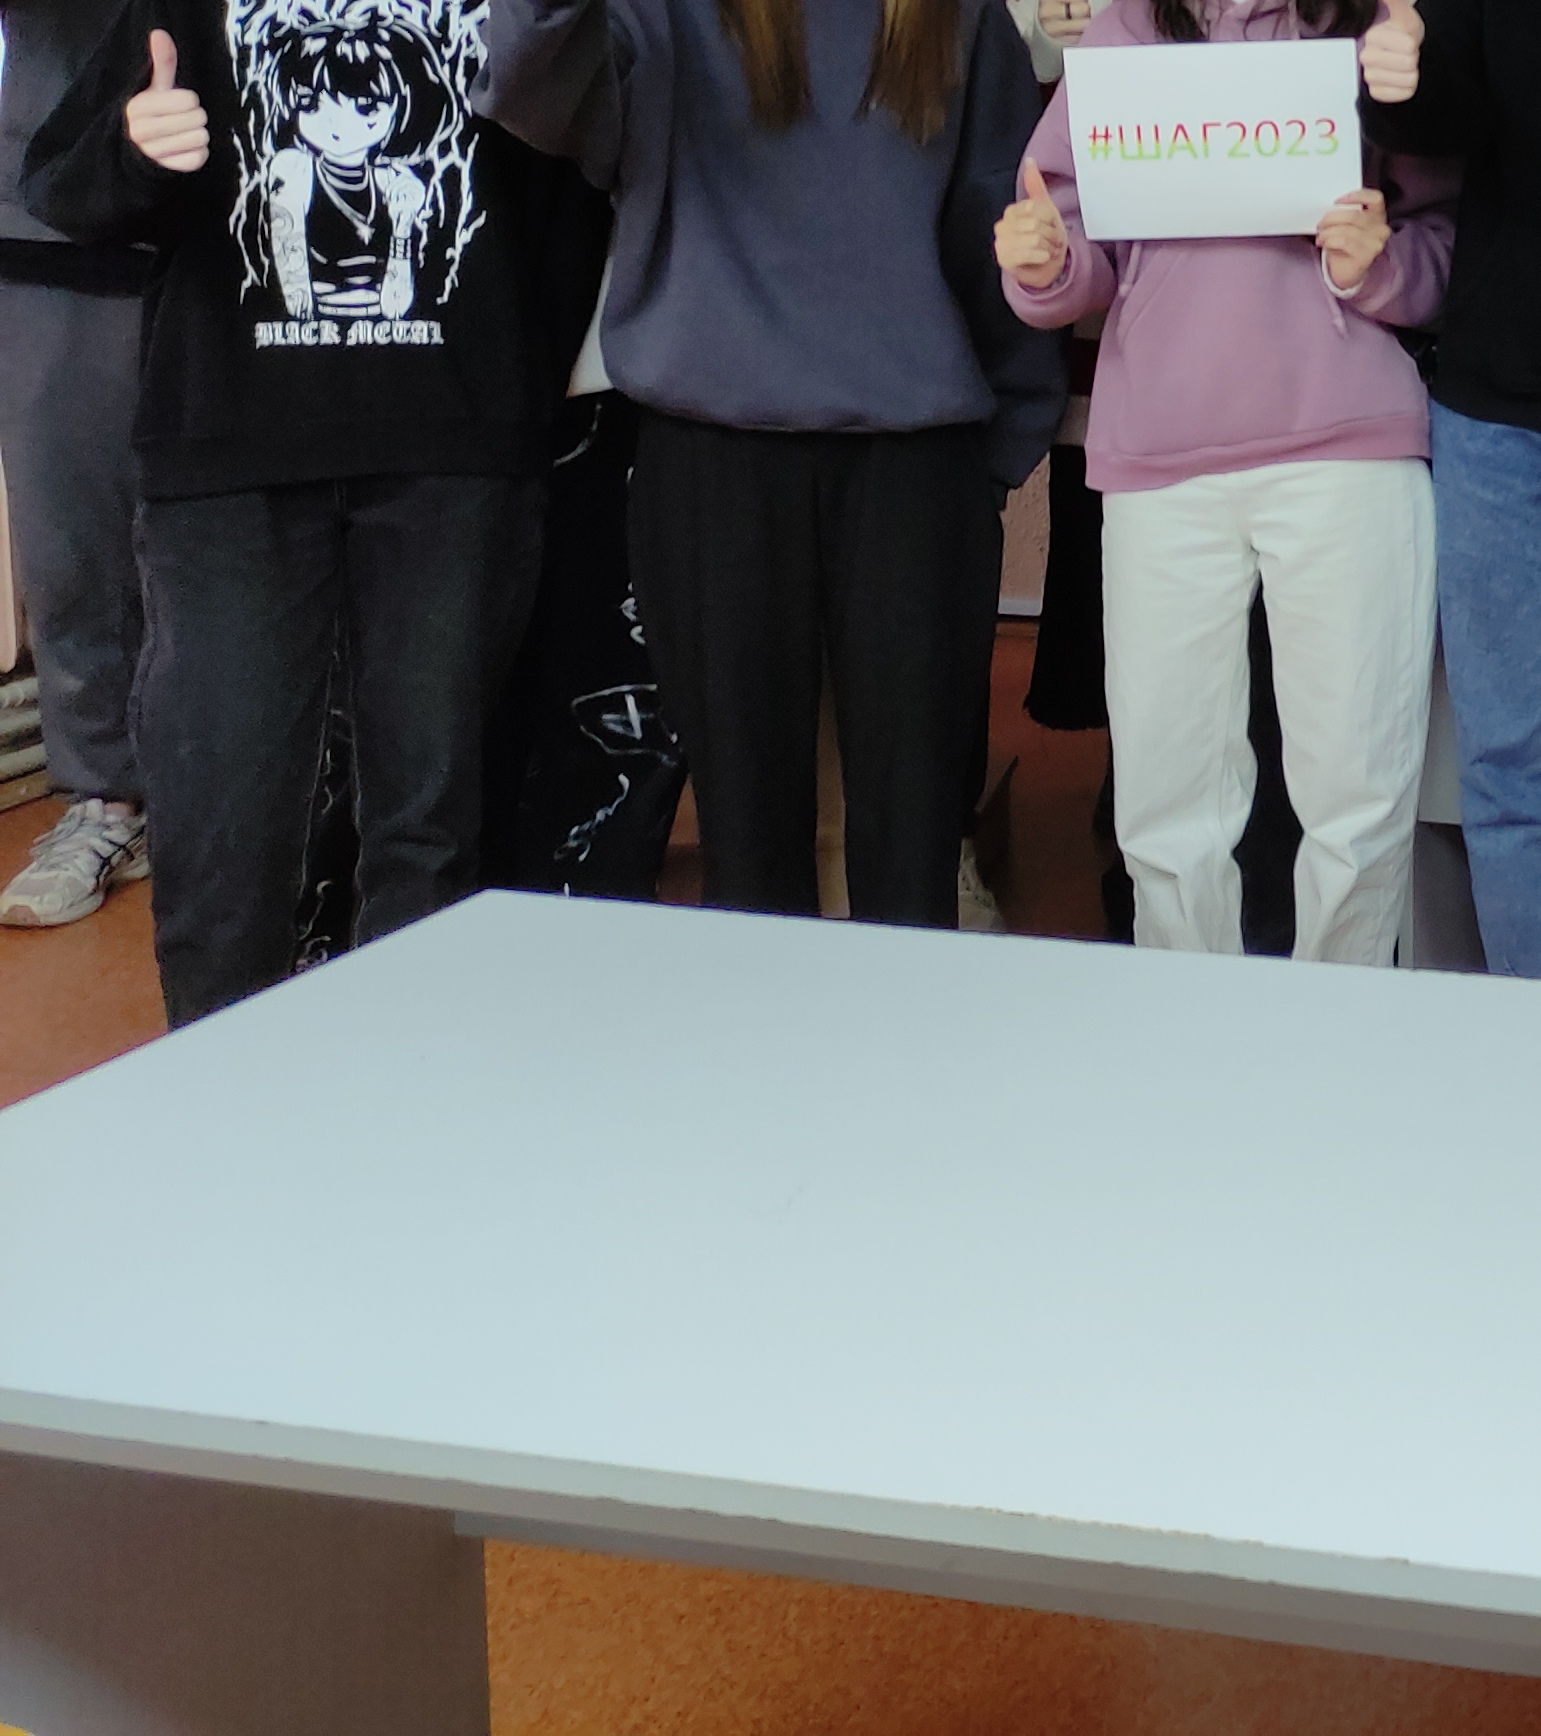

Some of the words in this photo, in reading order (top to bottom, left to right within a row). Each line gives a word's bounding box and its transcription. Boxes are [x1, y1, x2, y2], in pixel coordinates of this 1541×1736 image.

[1087, 118, 1339, 160] #ШАГ2023
[255, 320, 341, 349] BLACK
[346, 319, 445, 347] METAL
